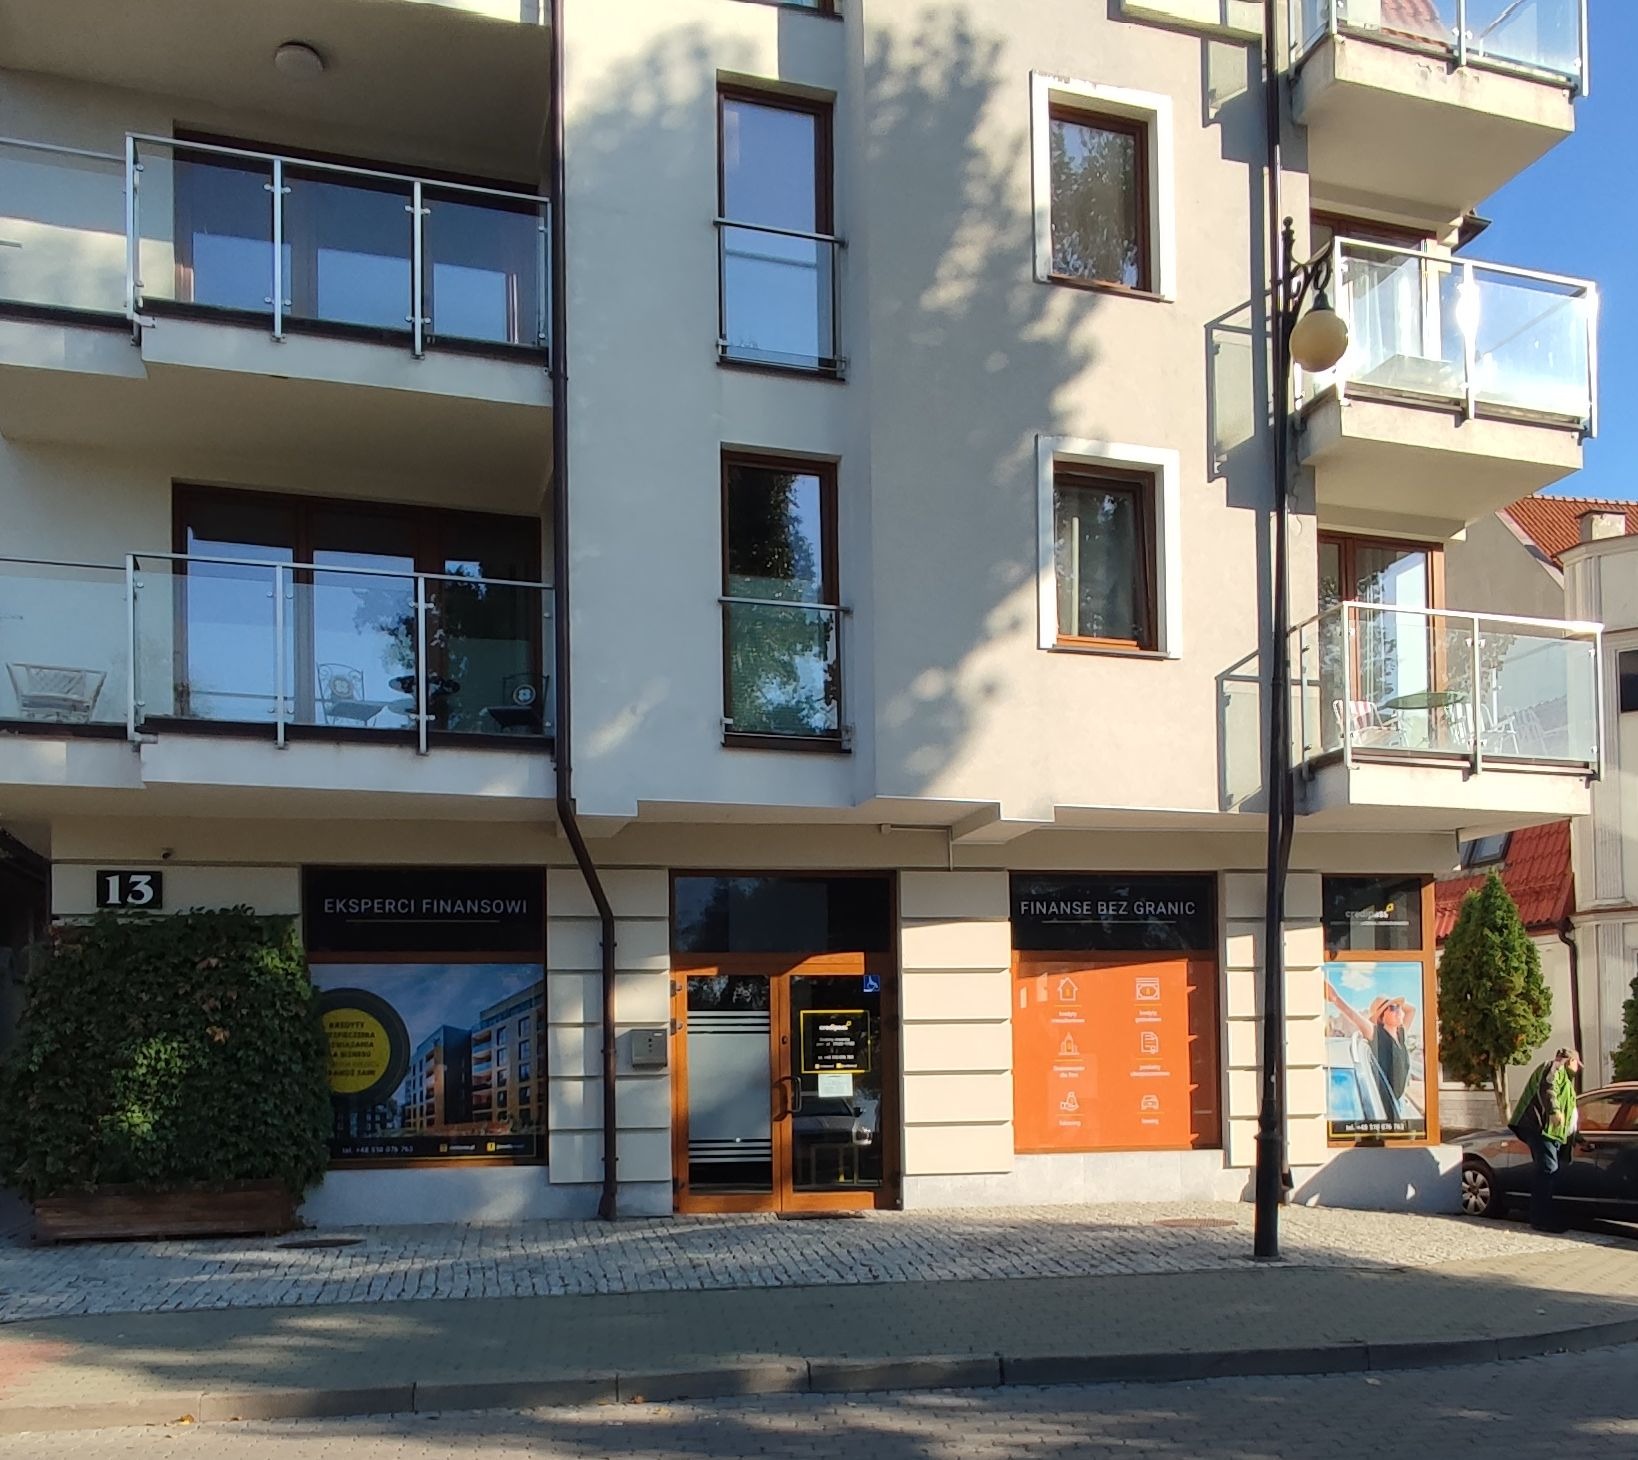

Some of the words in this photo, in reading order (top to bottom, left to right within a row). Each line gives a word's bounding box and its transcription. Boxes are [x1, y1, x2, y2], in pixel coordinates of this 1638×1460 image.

[105, 874, 154, 905] 13
[324, 898, 415, 914] EKSPERCI
[422, 899, 528, 914] FINANSOWI
[1020, 901, 1092, 915] FINANSE
[1097, 901, 1128, 915] BEZ
[1133, 901, 1196, 915] GRANIC
